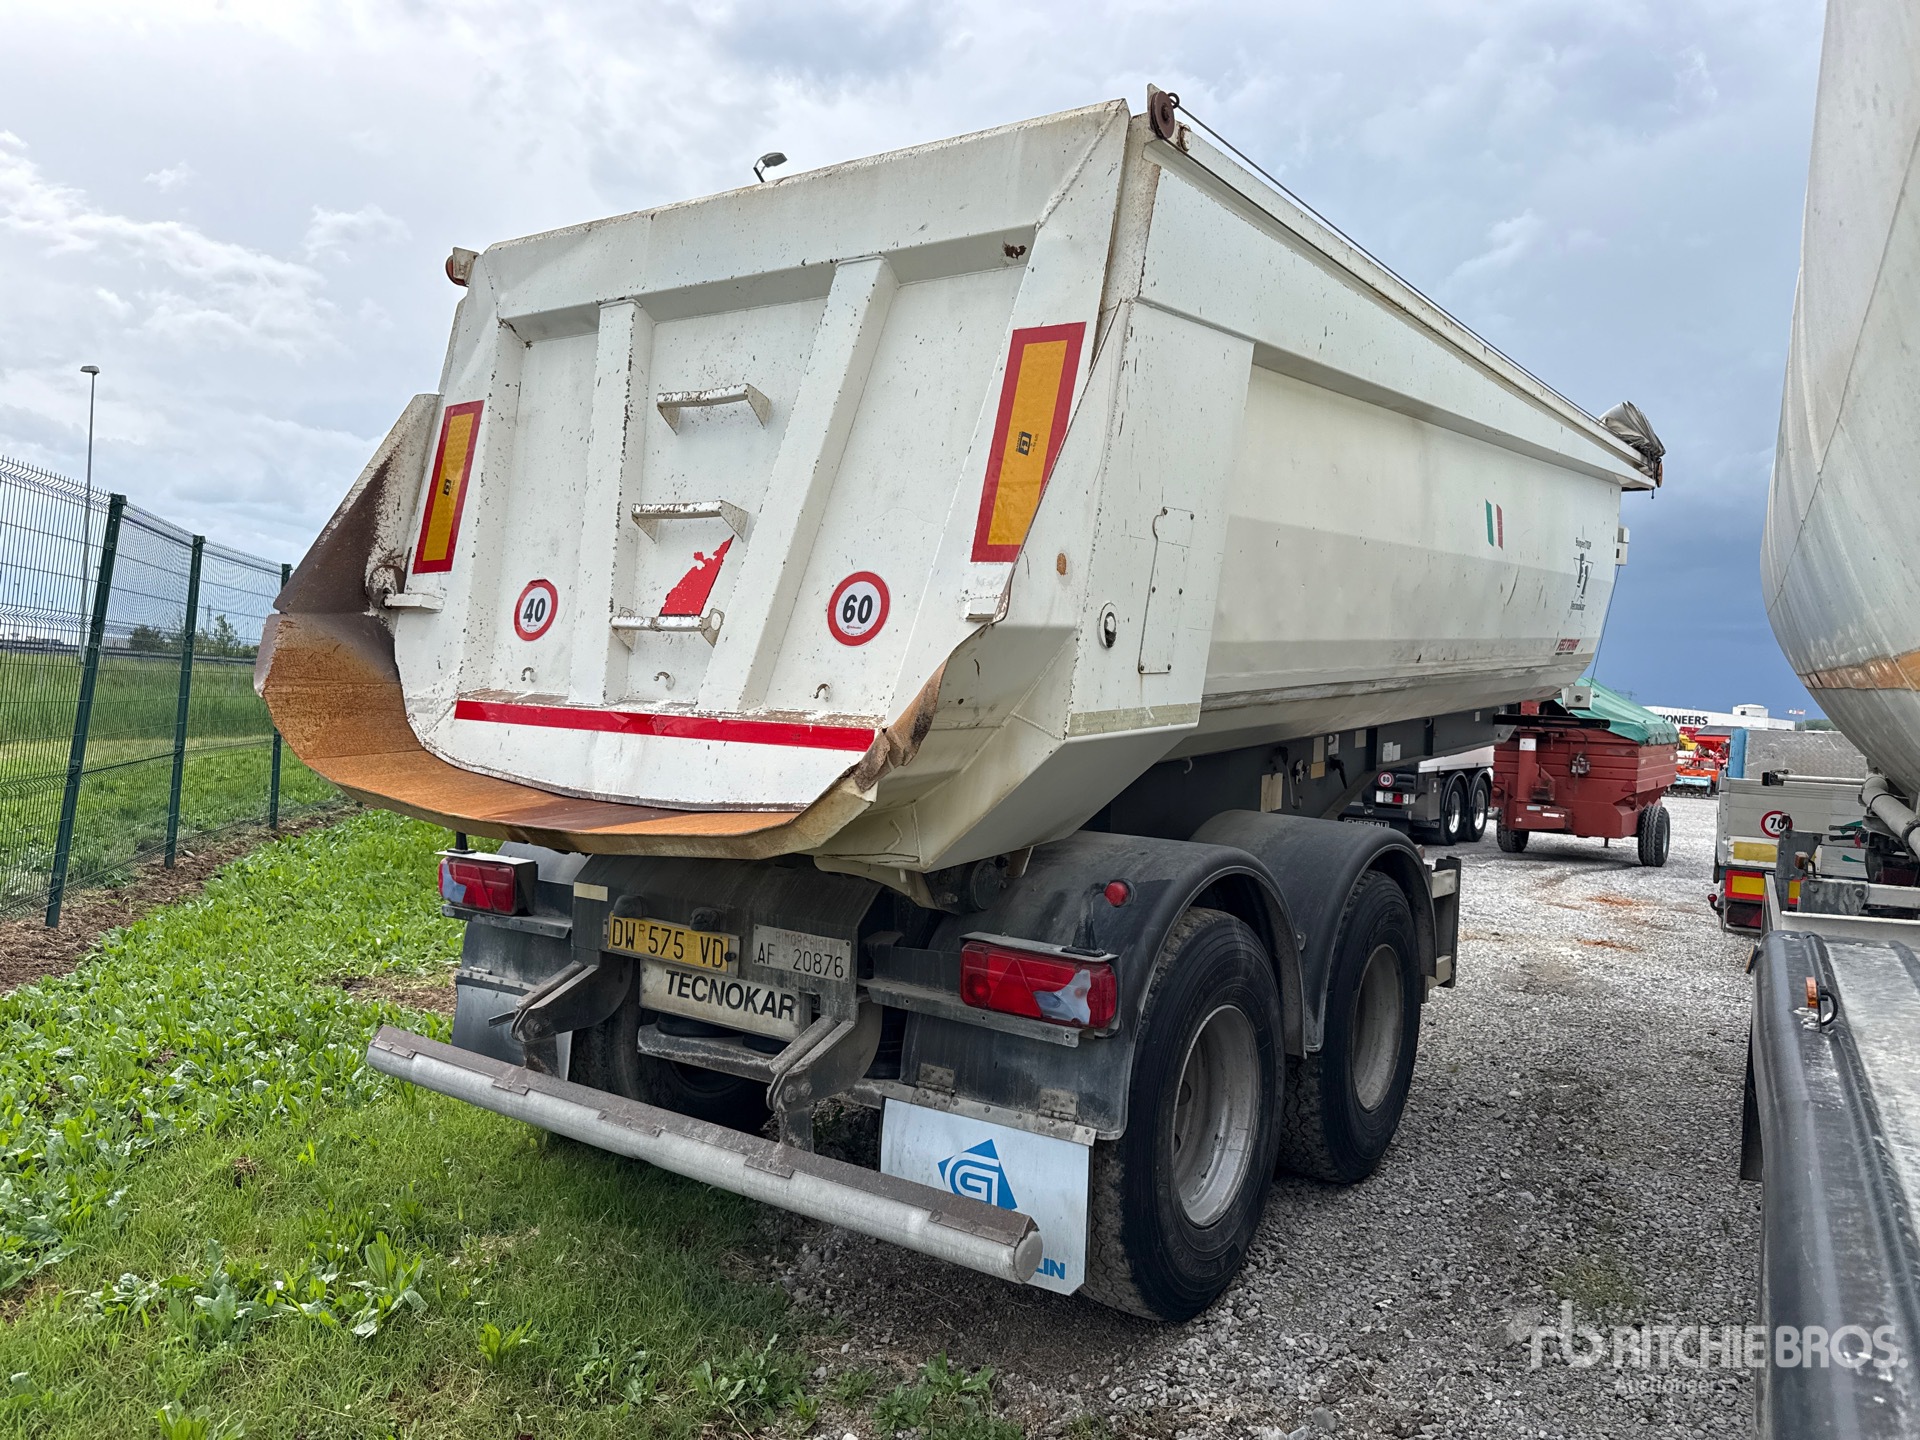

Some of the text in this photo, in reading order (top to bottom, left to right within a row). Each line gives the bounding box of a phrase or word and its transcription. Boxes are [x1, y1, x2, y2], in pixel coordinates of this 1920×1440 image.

[523, 598, 546, 622] 40
[842, 594, 873, 624] 60
[1770, 817, 1785, 830] 70
[612, 919, 635, 950] DW
[648, 926, 684, 960] 575
[700, 936, 724, 968] VD
[757, 942, 844, 978] AF 20876
[666, 970, 797, 1022] TECNOKAR
